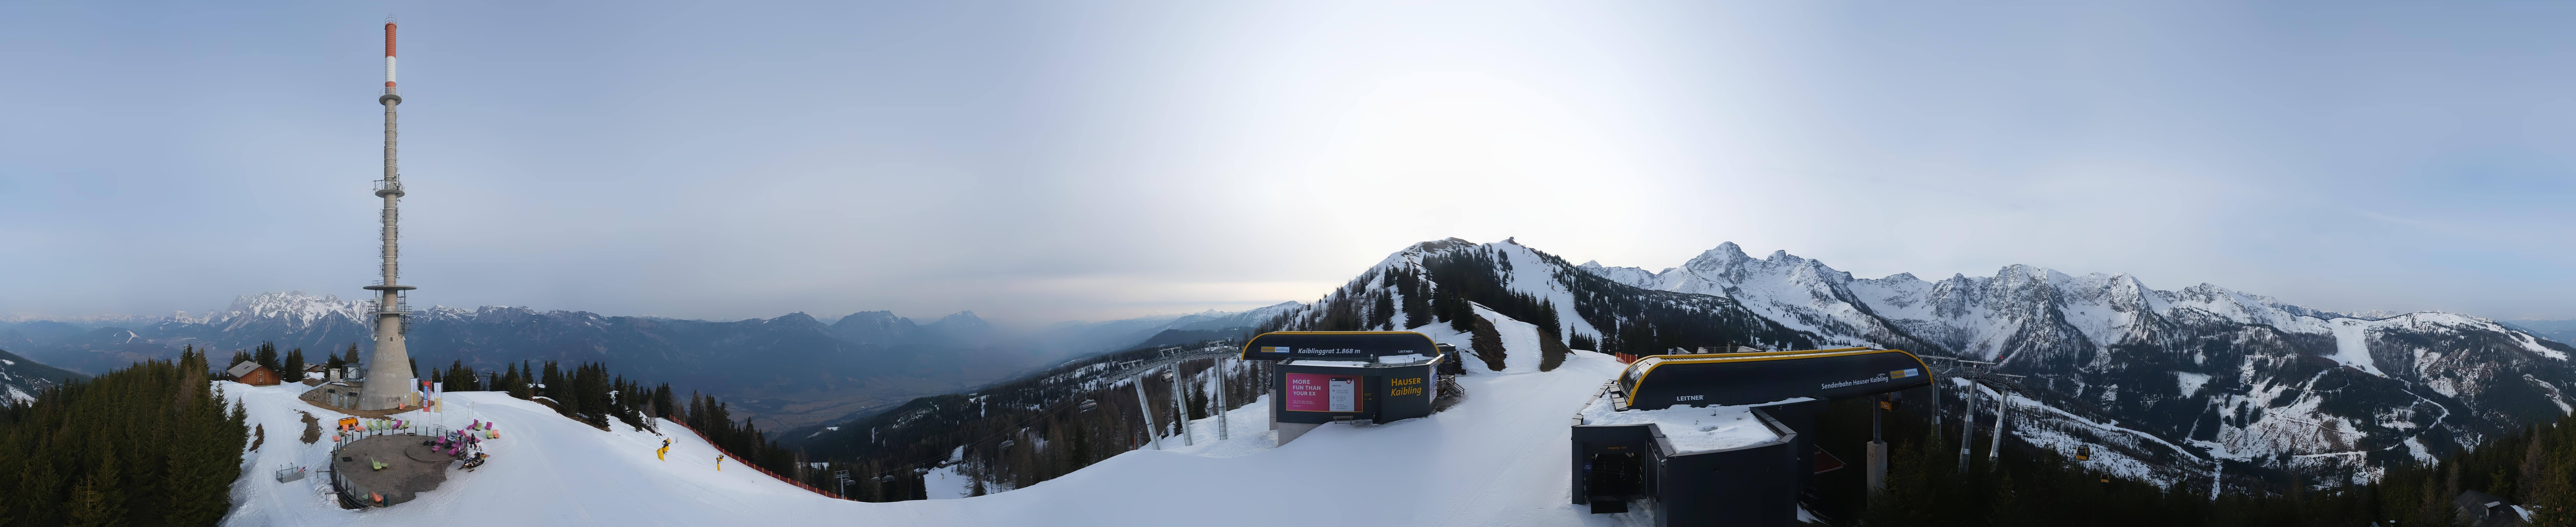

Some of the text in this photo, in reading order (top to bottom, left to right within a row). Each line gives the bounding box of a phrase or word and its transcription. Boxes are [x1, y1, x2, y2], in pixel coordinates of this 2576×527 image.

[1391, 378, 1421, 386] HAUSER
[1821, 380, 1852, 389] Senderbahn
[1391, 386, 1421, 396] Kaibling
